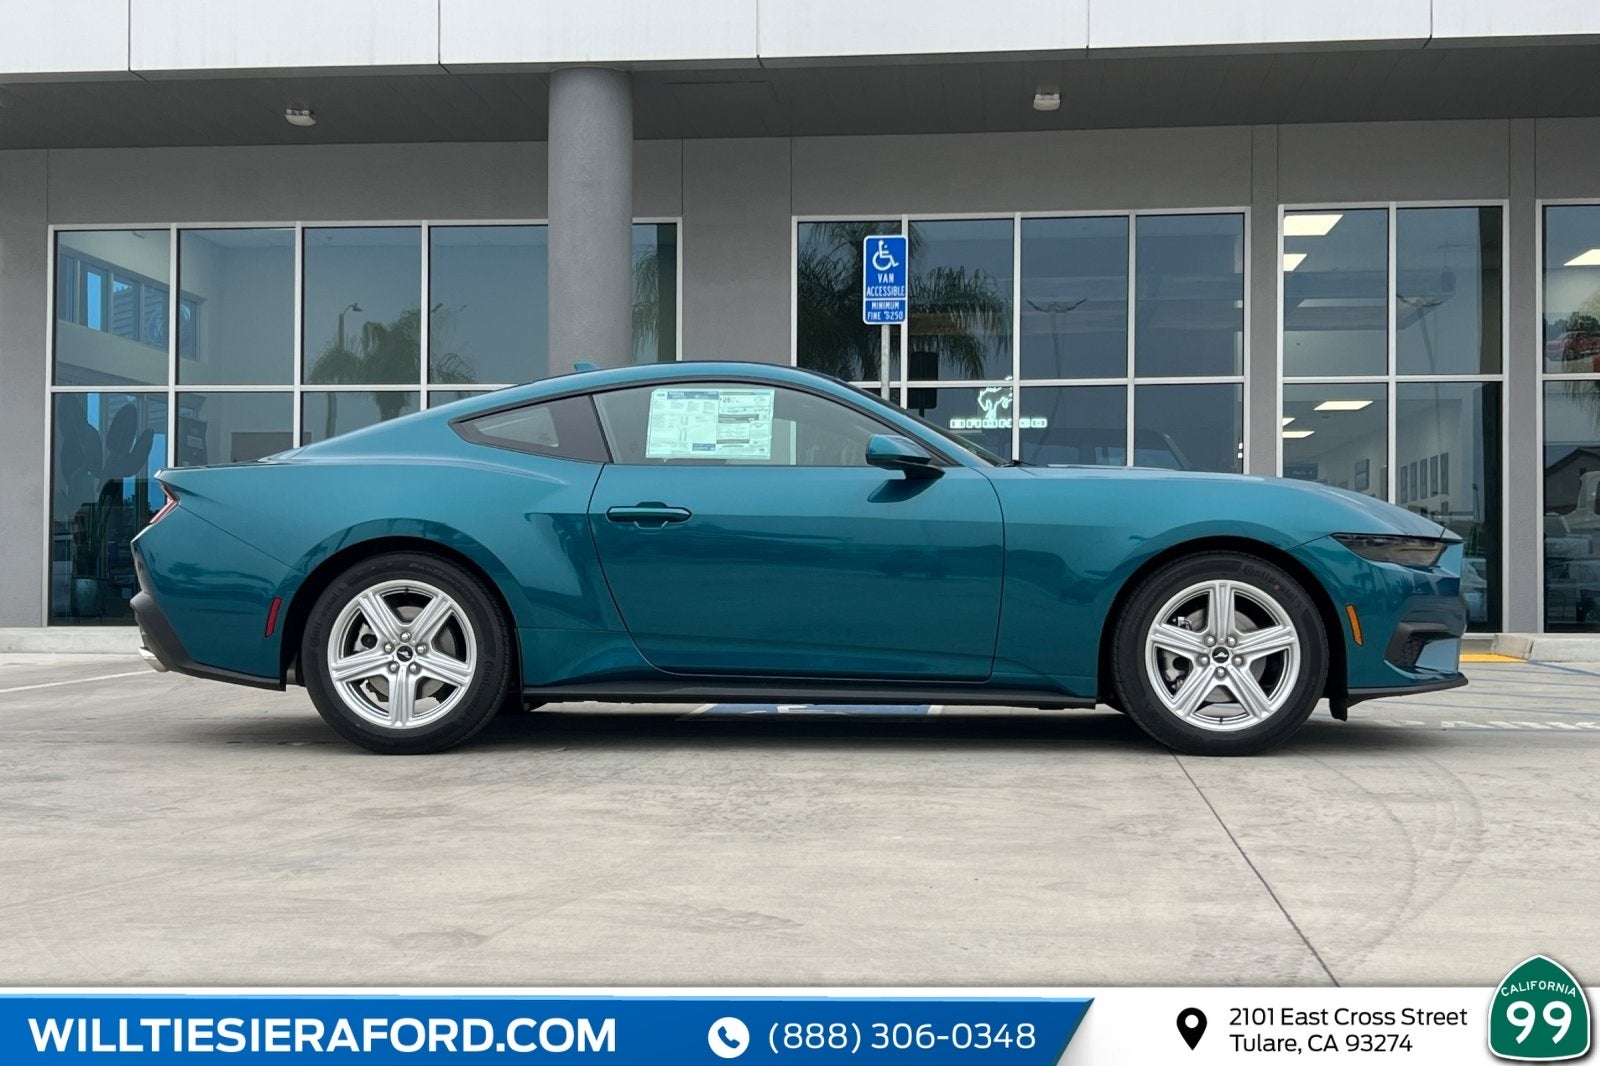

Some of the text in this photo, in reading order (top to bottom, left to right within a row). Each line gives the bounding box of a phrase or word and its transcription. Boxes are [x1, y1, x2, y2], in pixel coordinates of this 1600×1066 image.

[877, 272, 895, 284] VAN
[866, 285, 905, 297] ACCESSIBLE
[871, 301, 900, 310] MINIMUM
[867, 310, 904, 320] FINE $250
